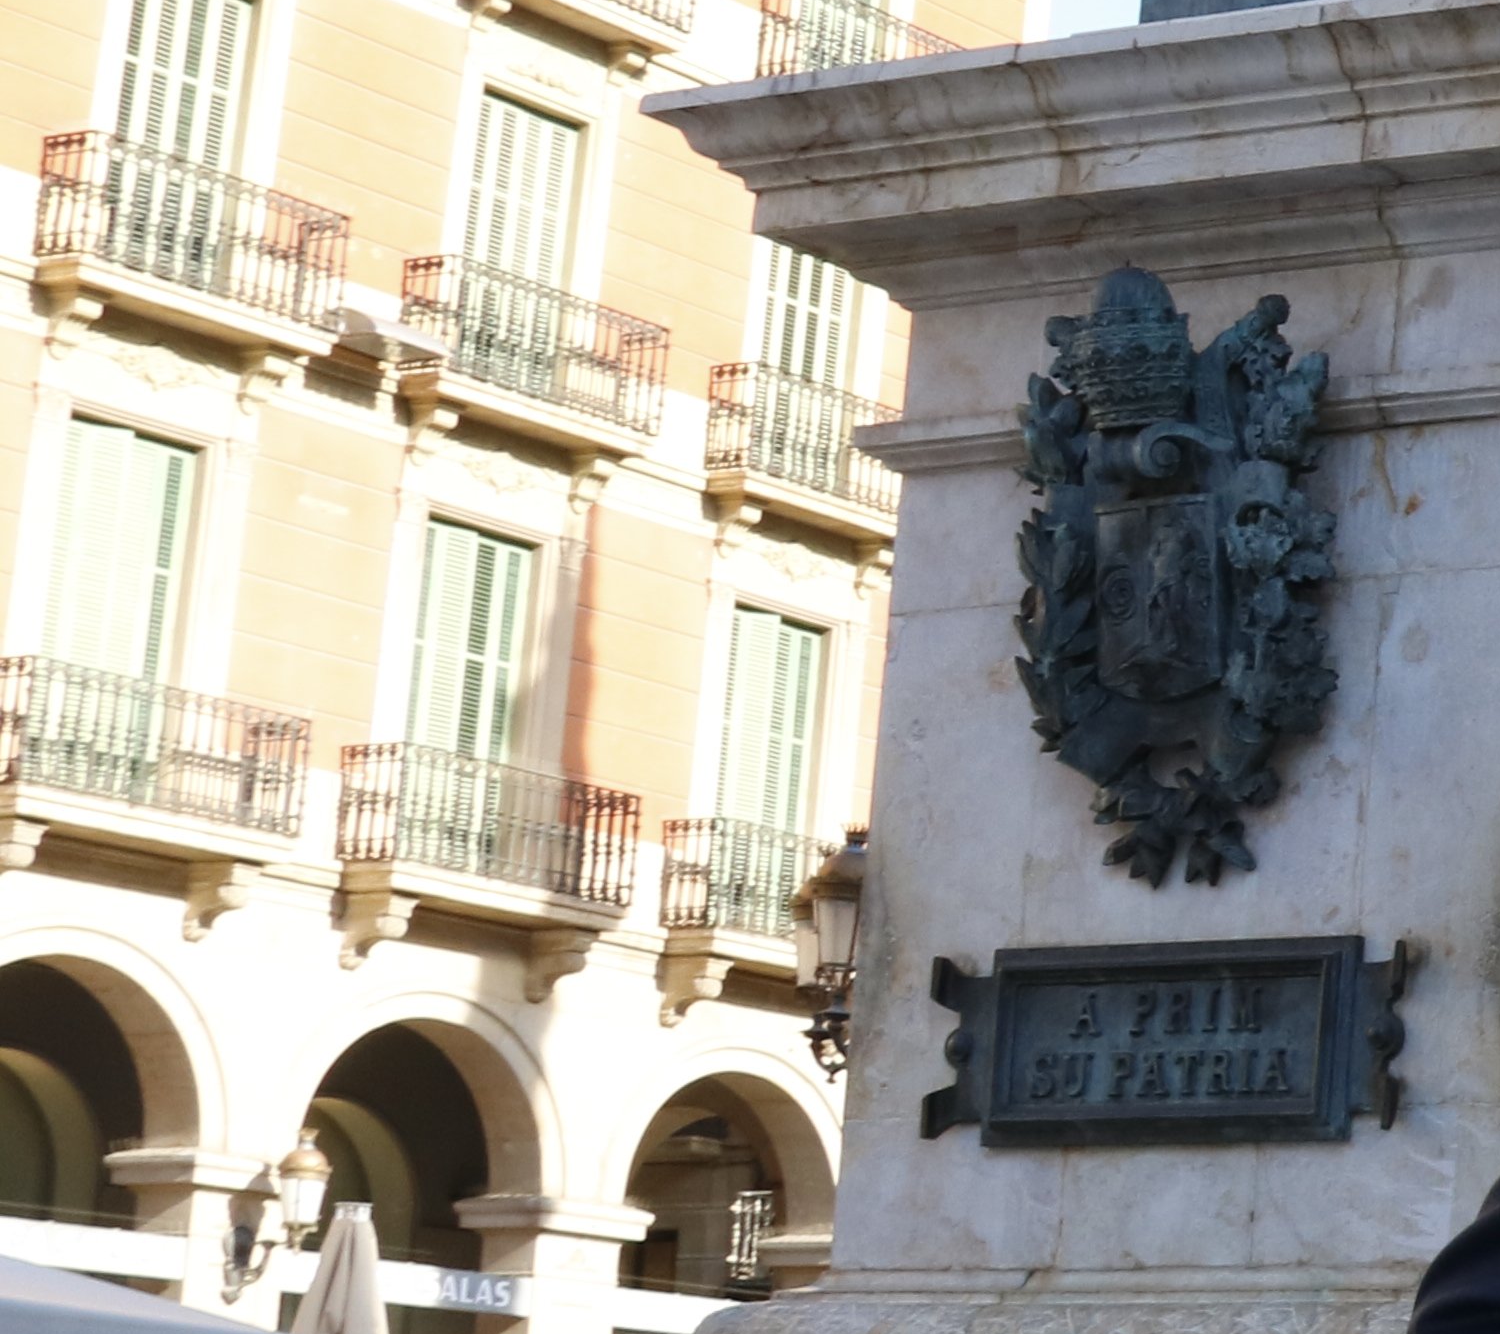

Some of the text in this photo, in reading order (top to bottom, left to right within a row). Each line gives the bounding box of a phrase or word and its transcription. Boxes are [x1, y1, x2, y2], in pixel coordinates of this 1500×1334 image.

[1069, 985, 1264, 1039] A PRIM
[1030, 1048, 1290, 1100] SU PATRIA
[434, 1274, 511, 1308] ALAS
